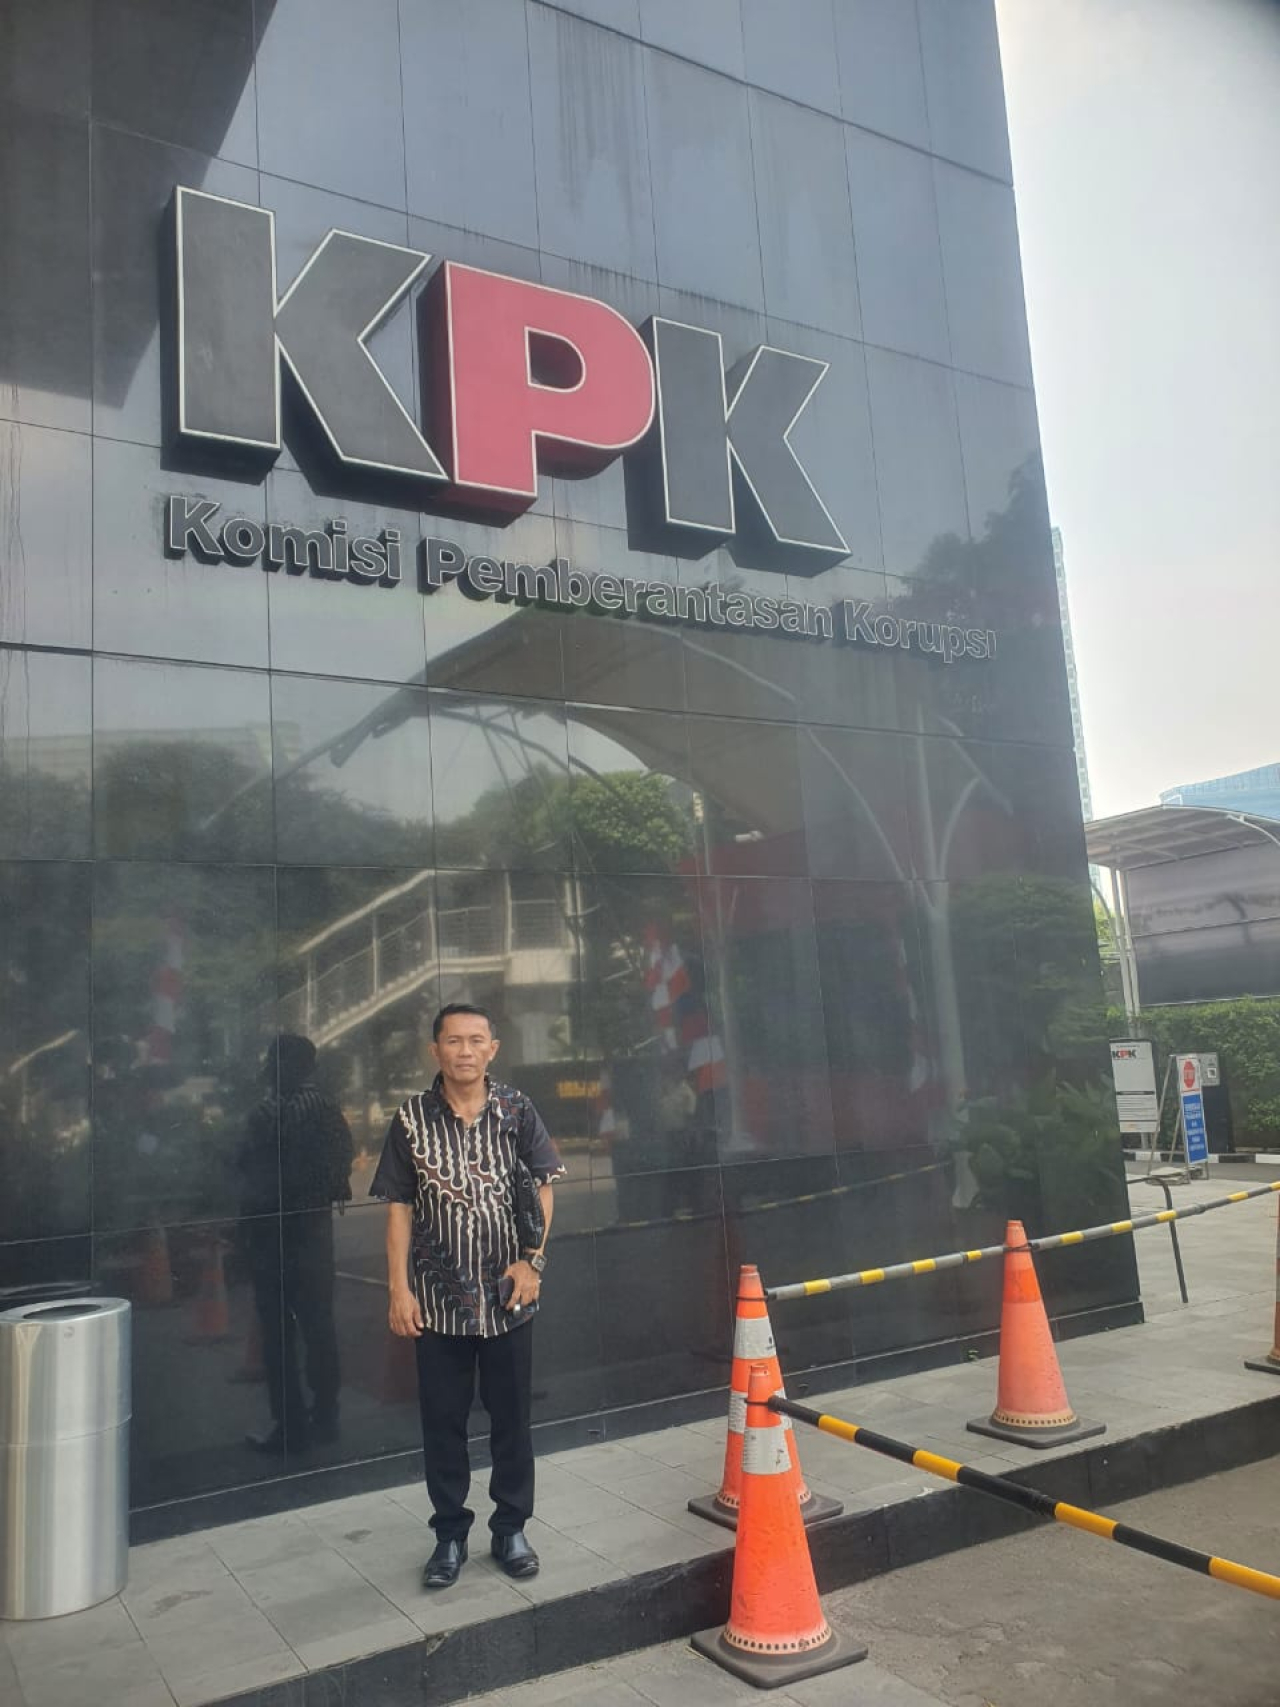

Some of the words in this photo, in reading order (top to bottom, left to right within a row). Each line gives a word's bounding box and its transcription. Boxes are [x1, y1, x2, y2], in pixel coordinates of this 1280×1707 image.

[176, 184, 852, 558] KPK
[168, 494, 402, 582] Komisi
[426, 536, 834, 638] Pemberantasan
[844, 600, 997, 663] Korupsi
[1111, 1049, 1136, 1059] KPK
